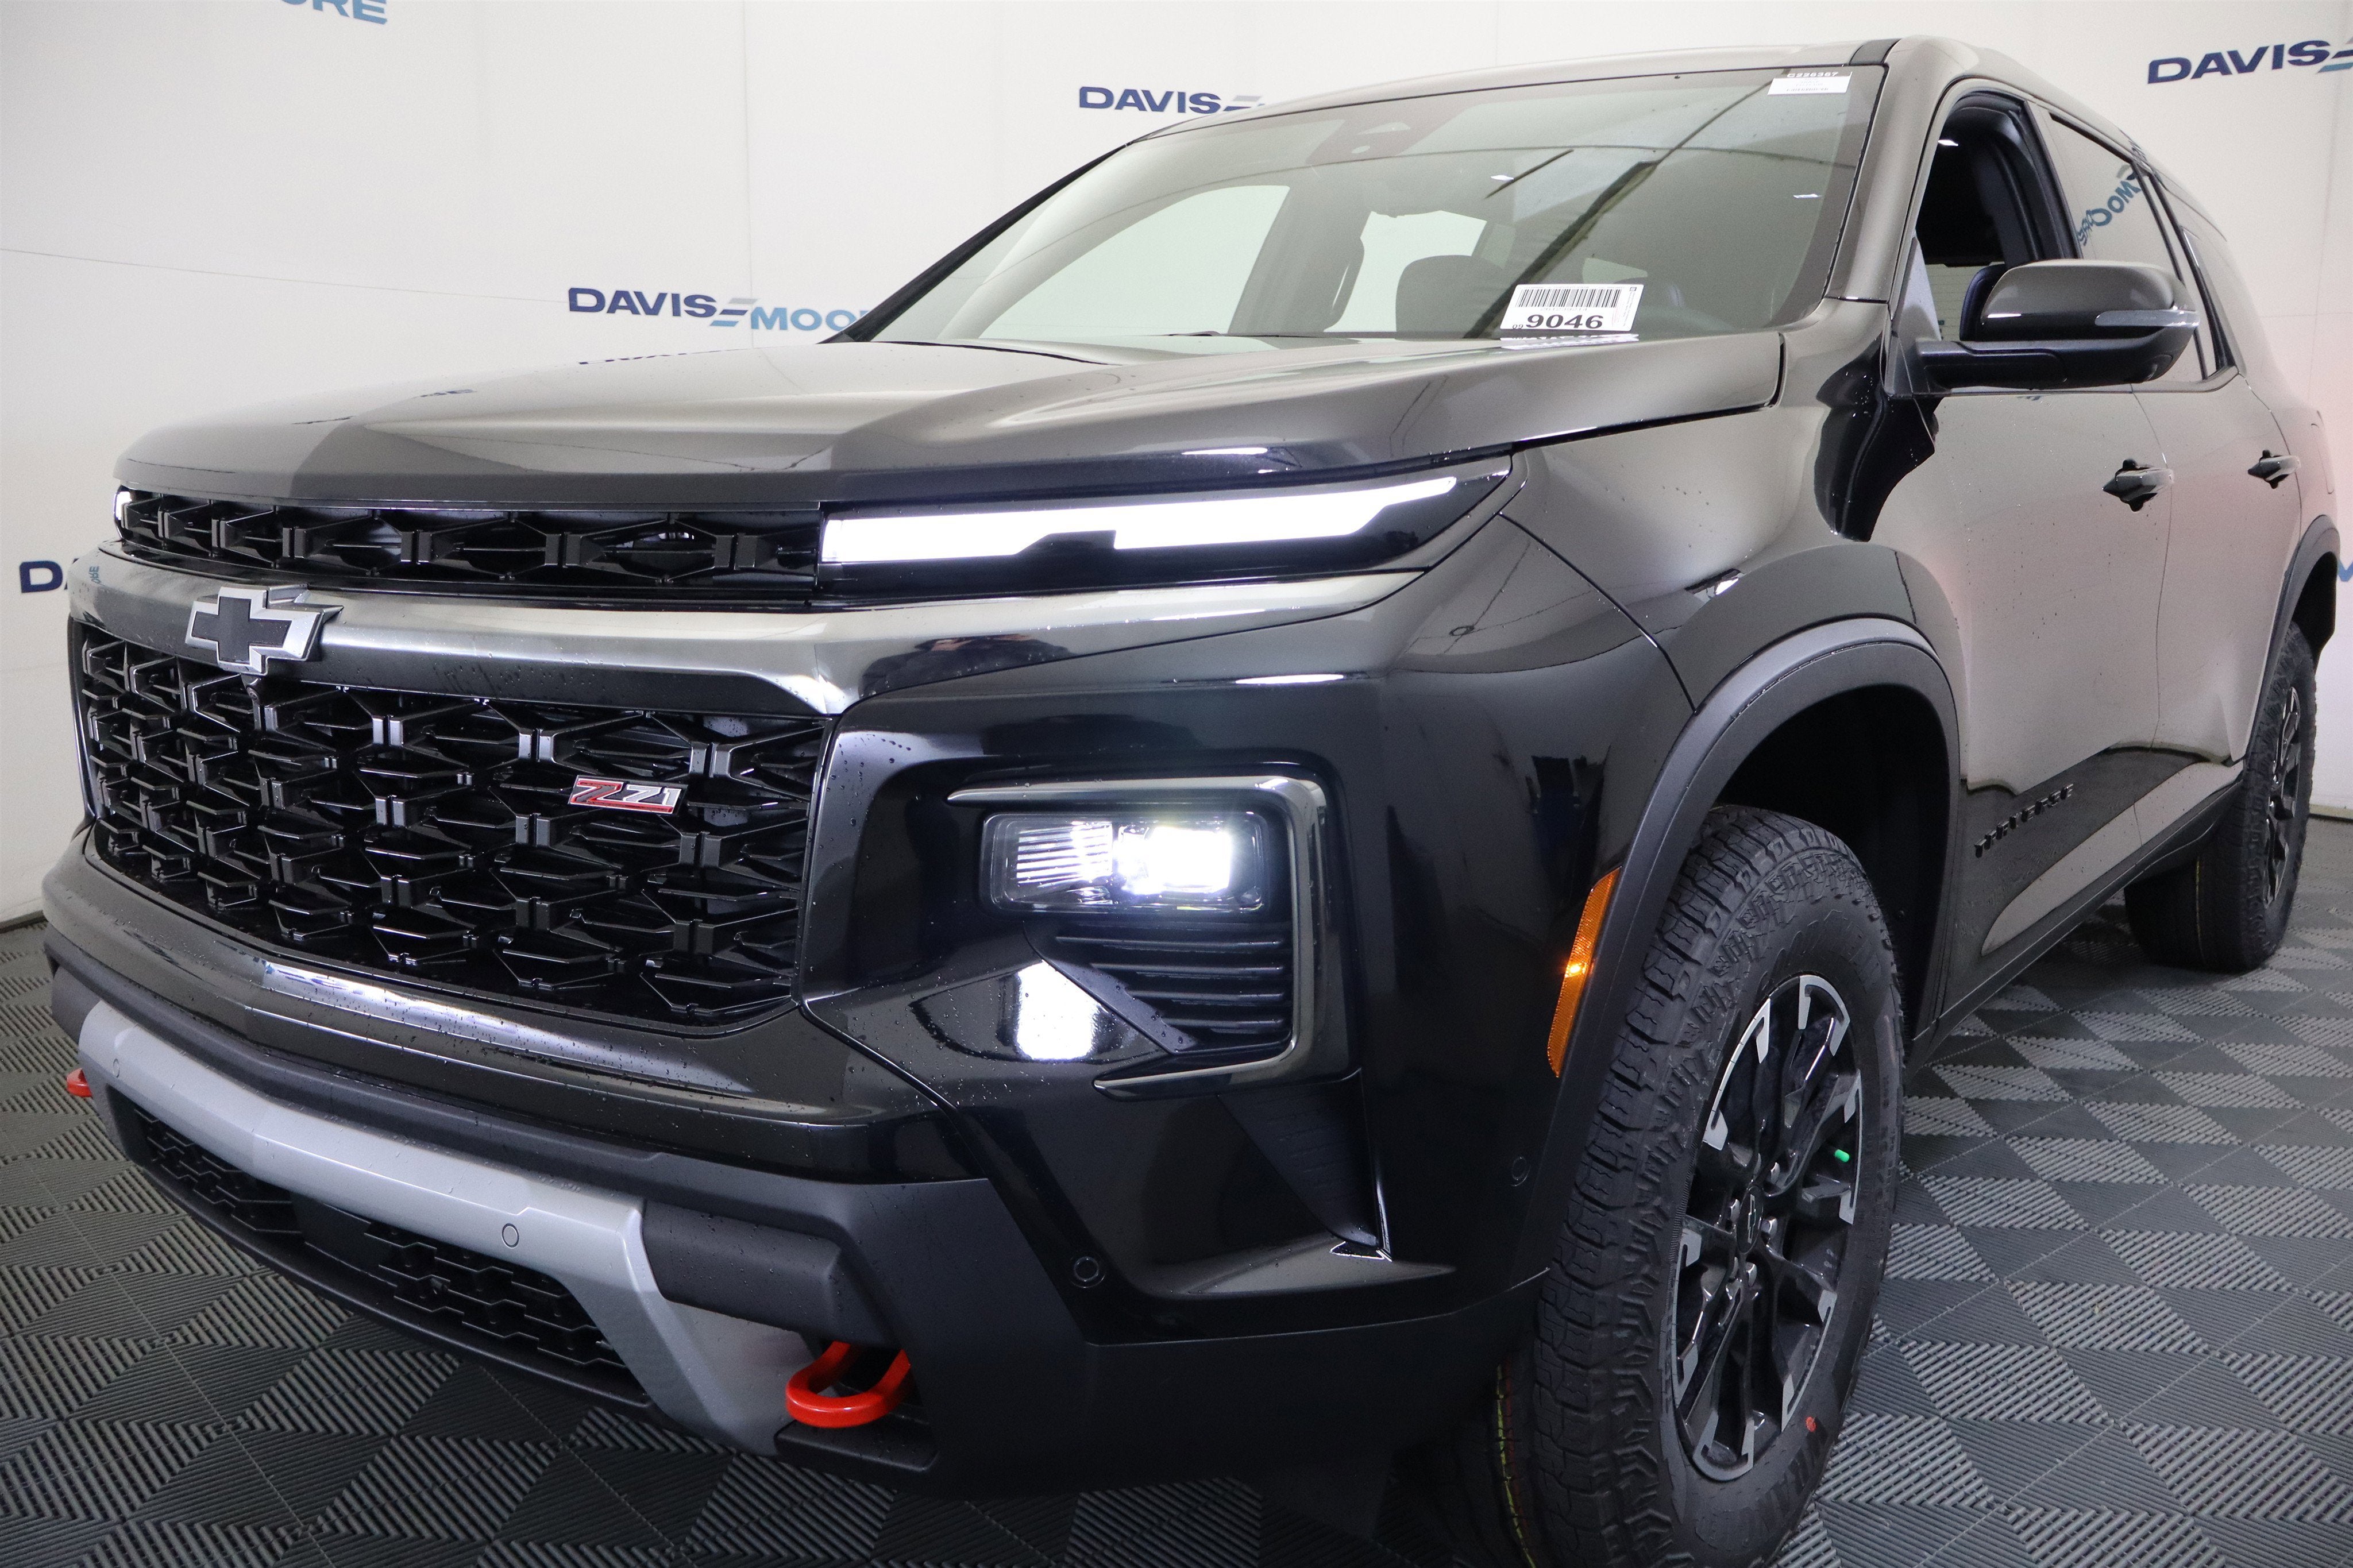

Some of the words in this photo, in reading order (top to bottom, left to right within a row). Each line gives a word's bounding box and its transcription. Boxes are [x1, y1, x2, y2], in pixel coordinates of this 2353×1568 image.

[2148, 40, 2329, 83] DAVIS
[1079, 86, 1221, 114] DAVIS
[569, 288, 716, 317] DAVIS
[751, 307, 870, 331] MOO
[1526, 314, 1603, 329] 9046
[570, 778, 682, 814] Z71
